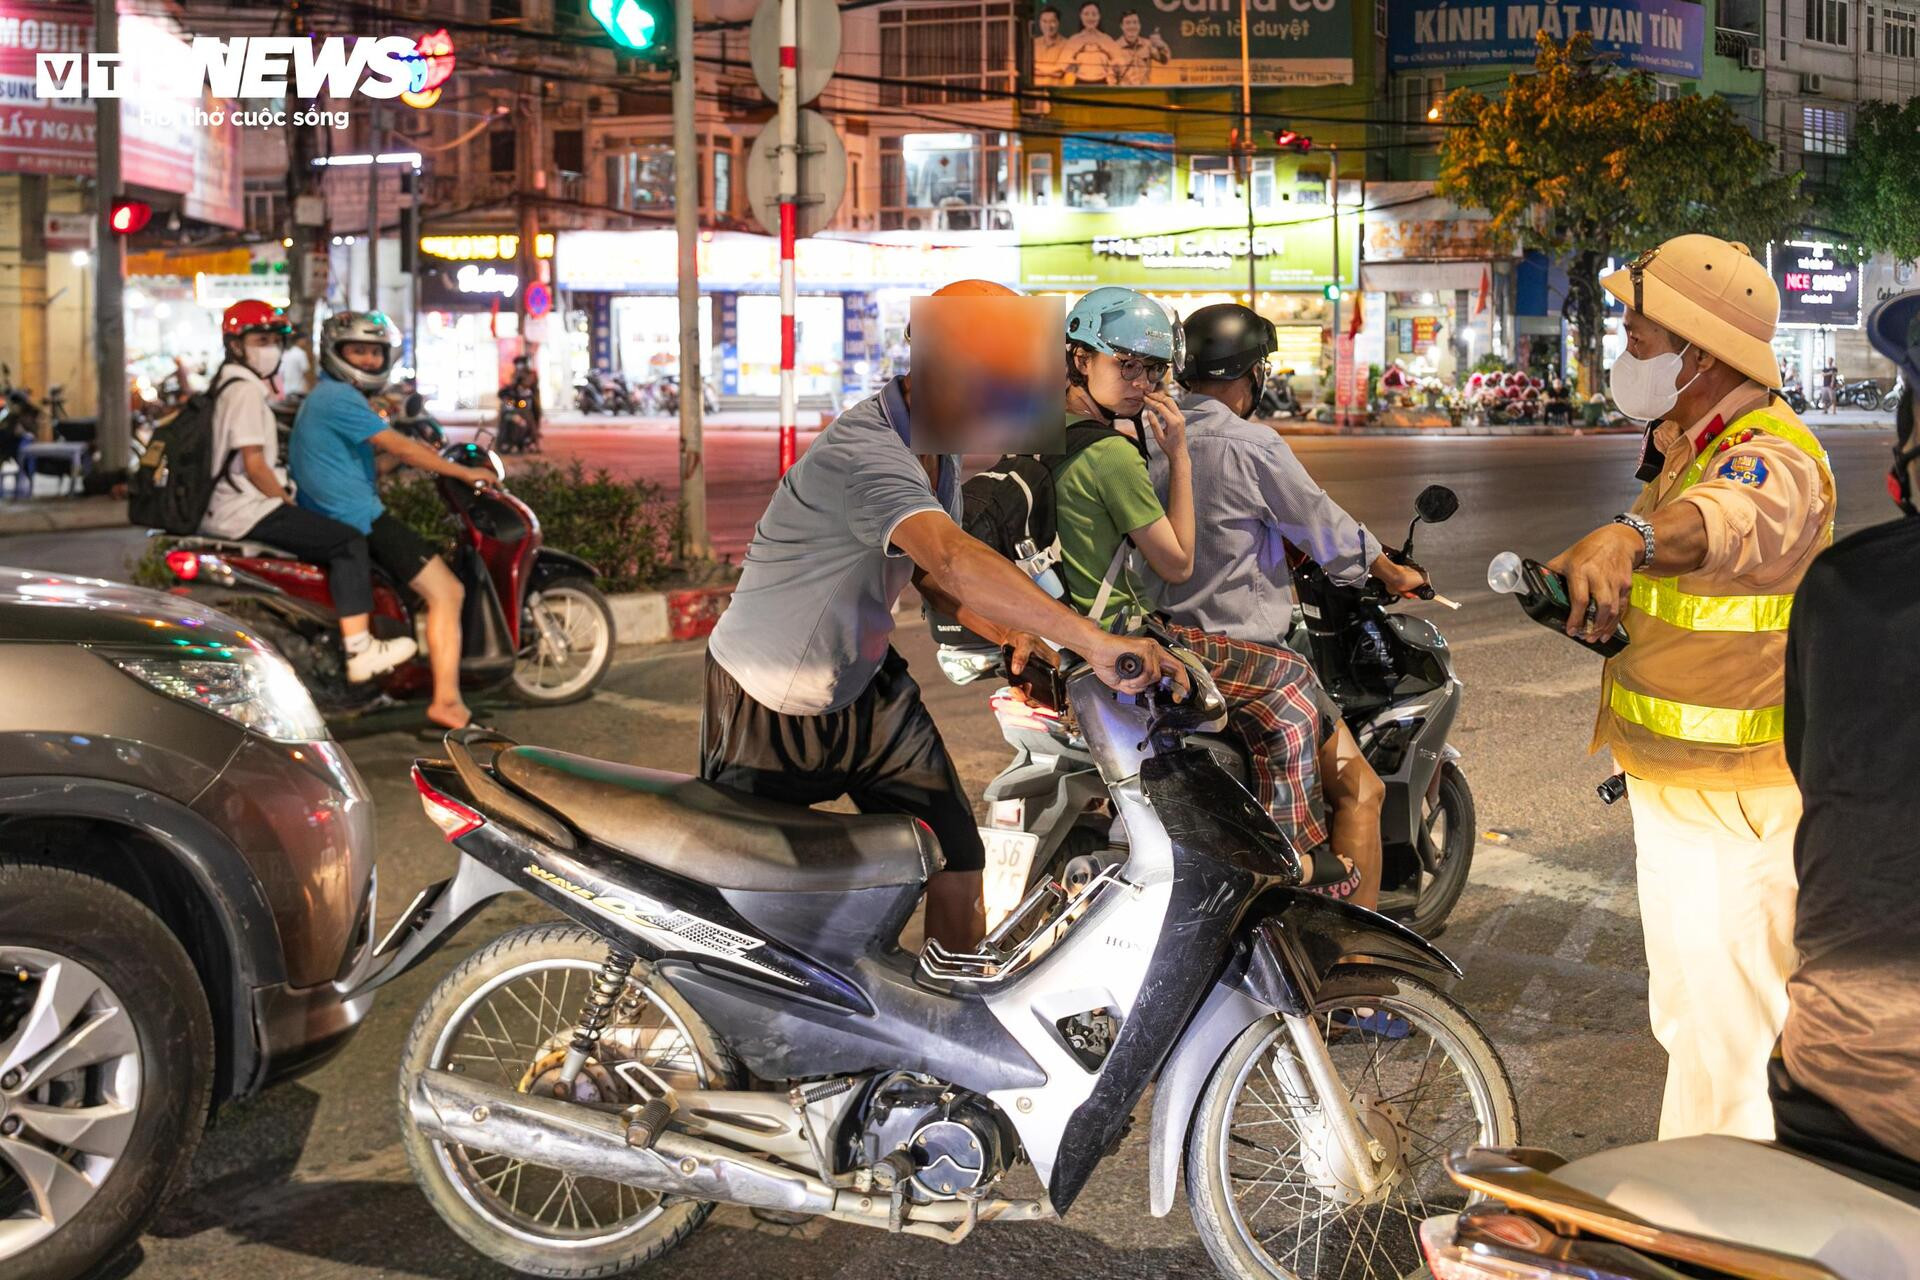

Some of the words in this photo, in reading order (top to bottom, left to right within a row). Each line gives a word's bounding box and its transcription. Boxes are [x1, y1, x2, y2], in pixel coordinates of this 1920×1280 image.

[1180, 17, 1221, 38] Đến
[1252, 18, 1310, 41] duyệt
[1414, 1, 1495, 44] KÍNH
[1589, 6, 1643, 49] VẠN
[1649, 8, 1683, 51] TÍN
[1179, 236, 1285, 257] GARDEN
[529, 863, 596, 900] WAVE
[1328, 874, 1360, 900] YOU
